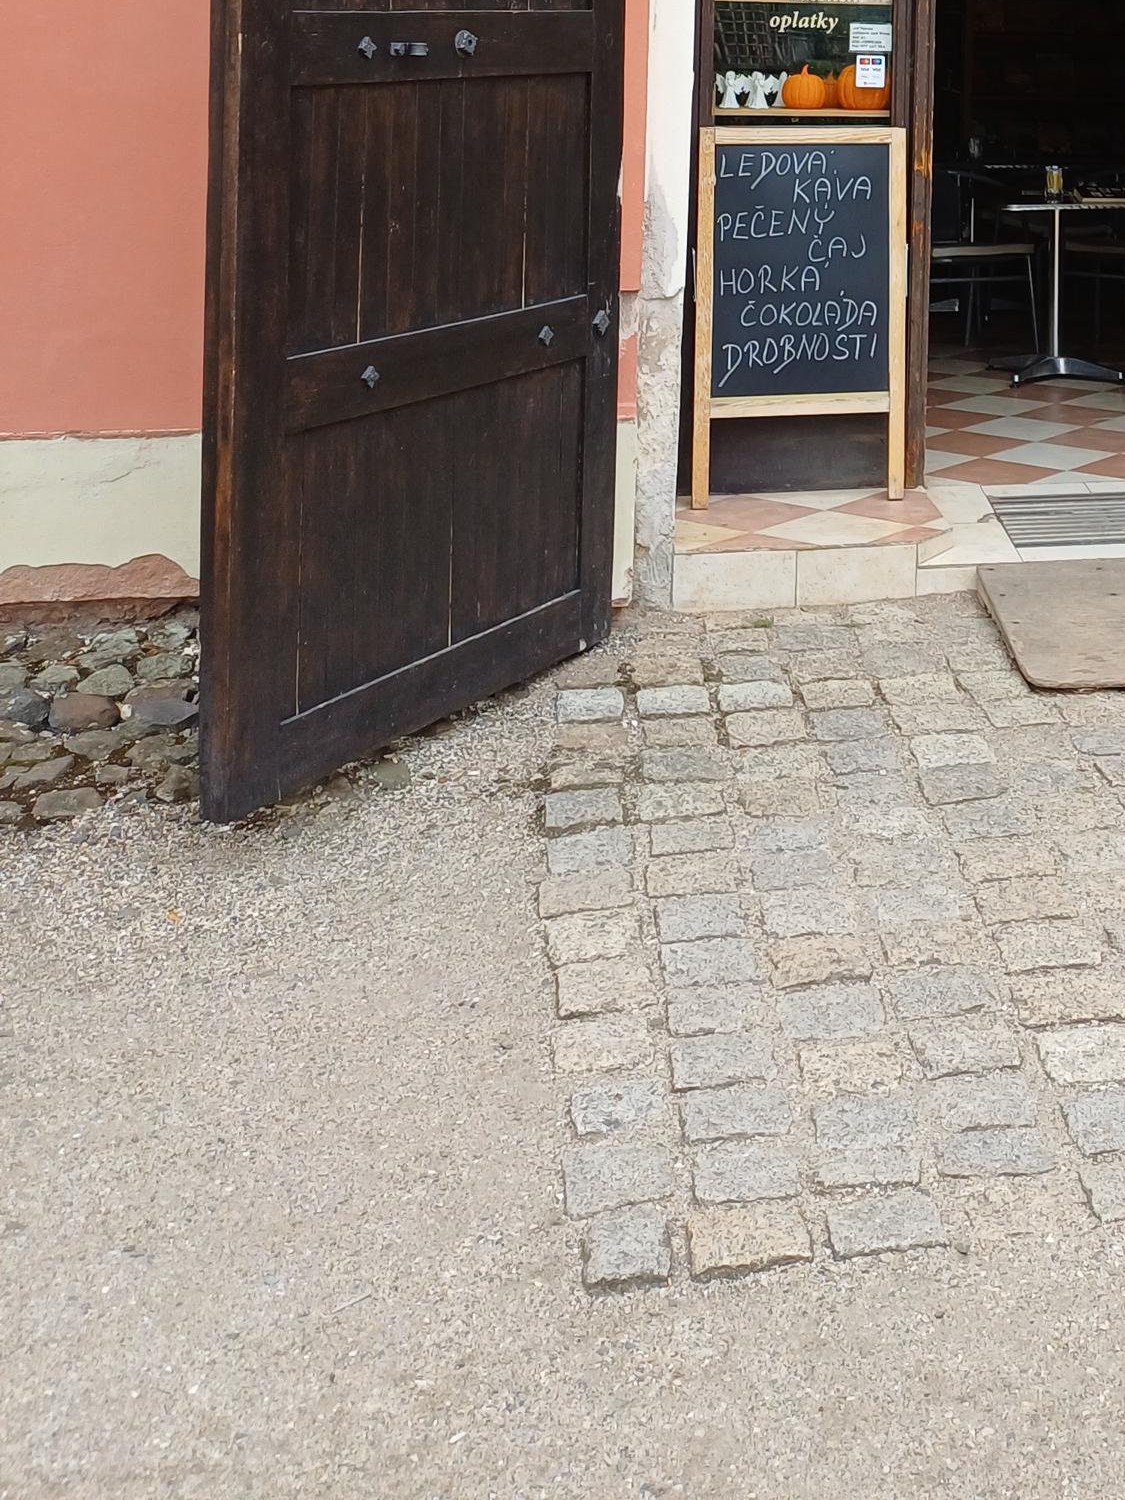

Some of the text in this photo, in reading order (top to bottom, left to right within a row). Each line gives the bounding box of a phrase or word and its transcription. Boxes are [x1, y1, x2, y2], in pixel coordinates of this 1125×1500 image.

[769, 9, 839, 34] oplatky
[793, 167, 872, 203] KÁVA
[717, 203, 835, 242] PEČENÝ
[808, 234, 867, 262] ČAJ
[720, 262, 830, 296] HORKÁ
[740, 289, 878, 332] ČOKOLÁDA
[718, 332, 878, 387] DROBNOSTI
